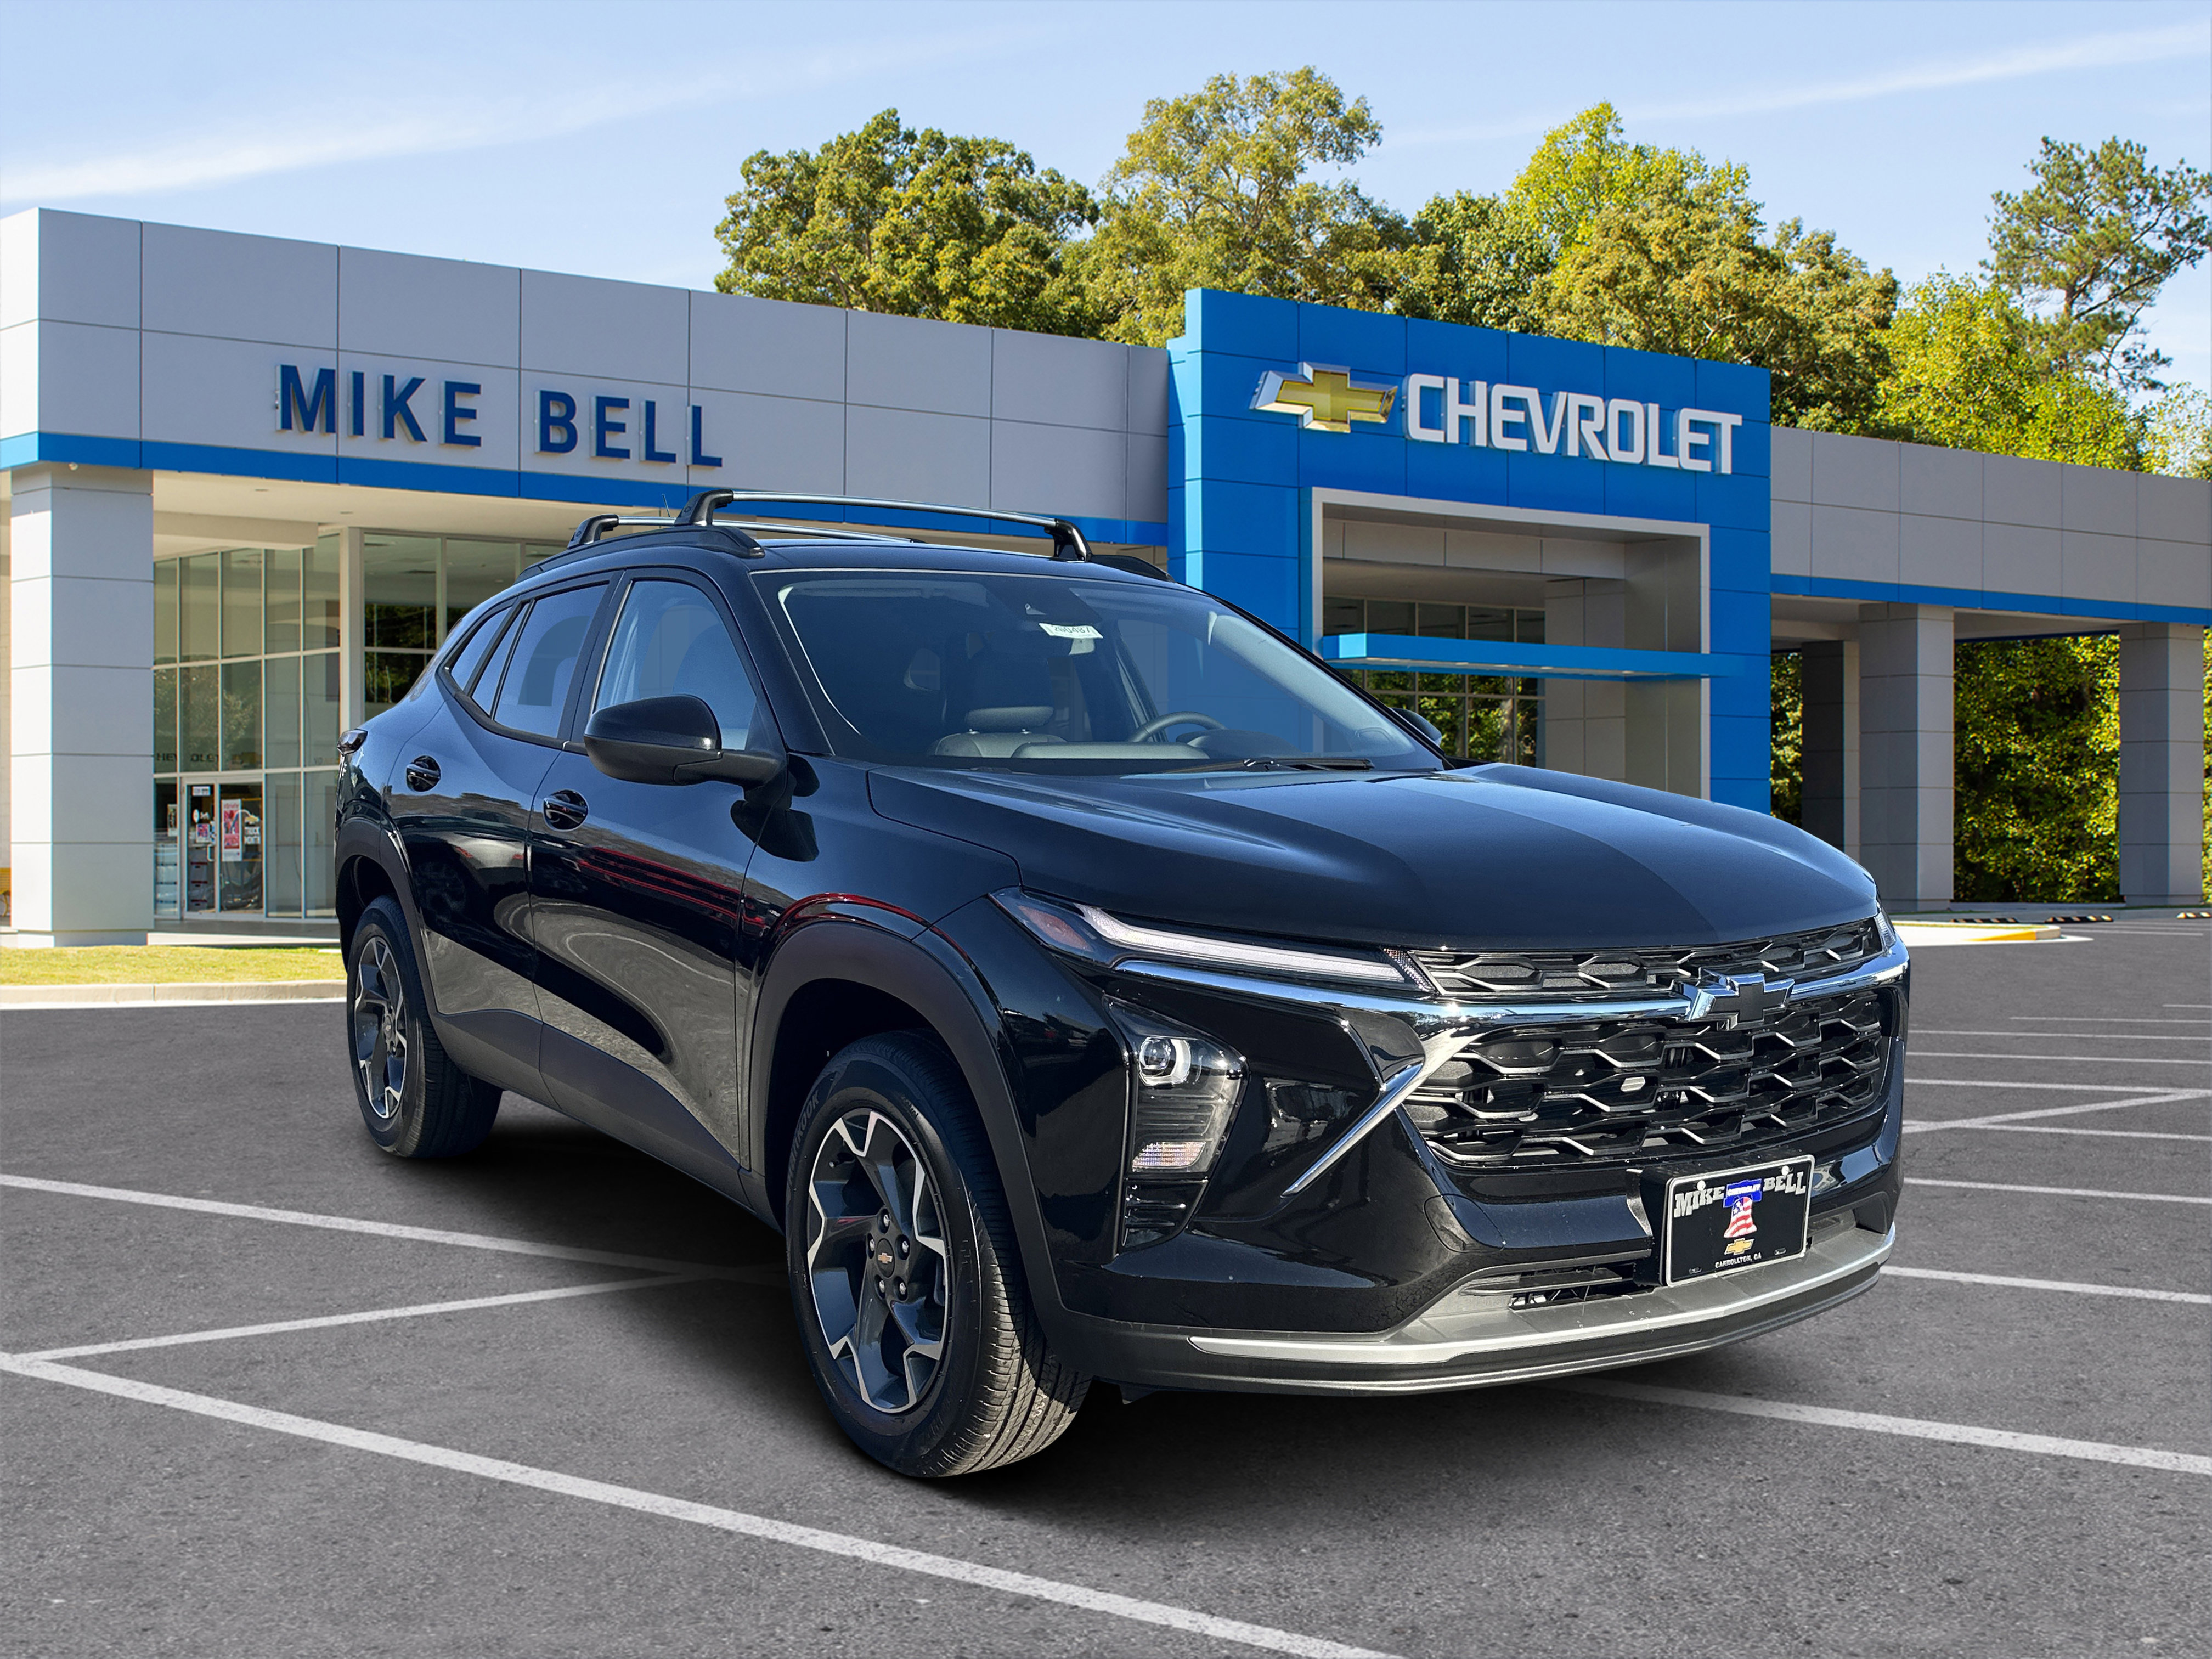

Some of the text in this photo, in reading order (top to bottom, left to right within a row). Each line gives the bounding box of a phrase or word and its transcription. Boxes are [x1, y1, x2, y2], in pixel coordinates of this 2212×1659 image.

[277, 364, 723, 467] MIKE BELL
[1403, 373, 1742, 475] CHEVROLET
[1674, 1171, 1806, 1218] MIKE BELL
